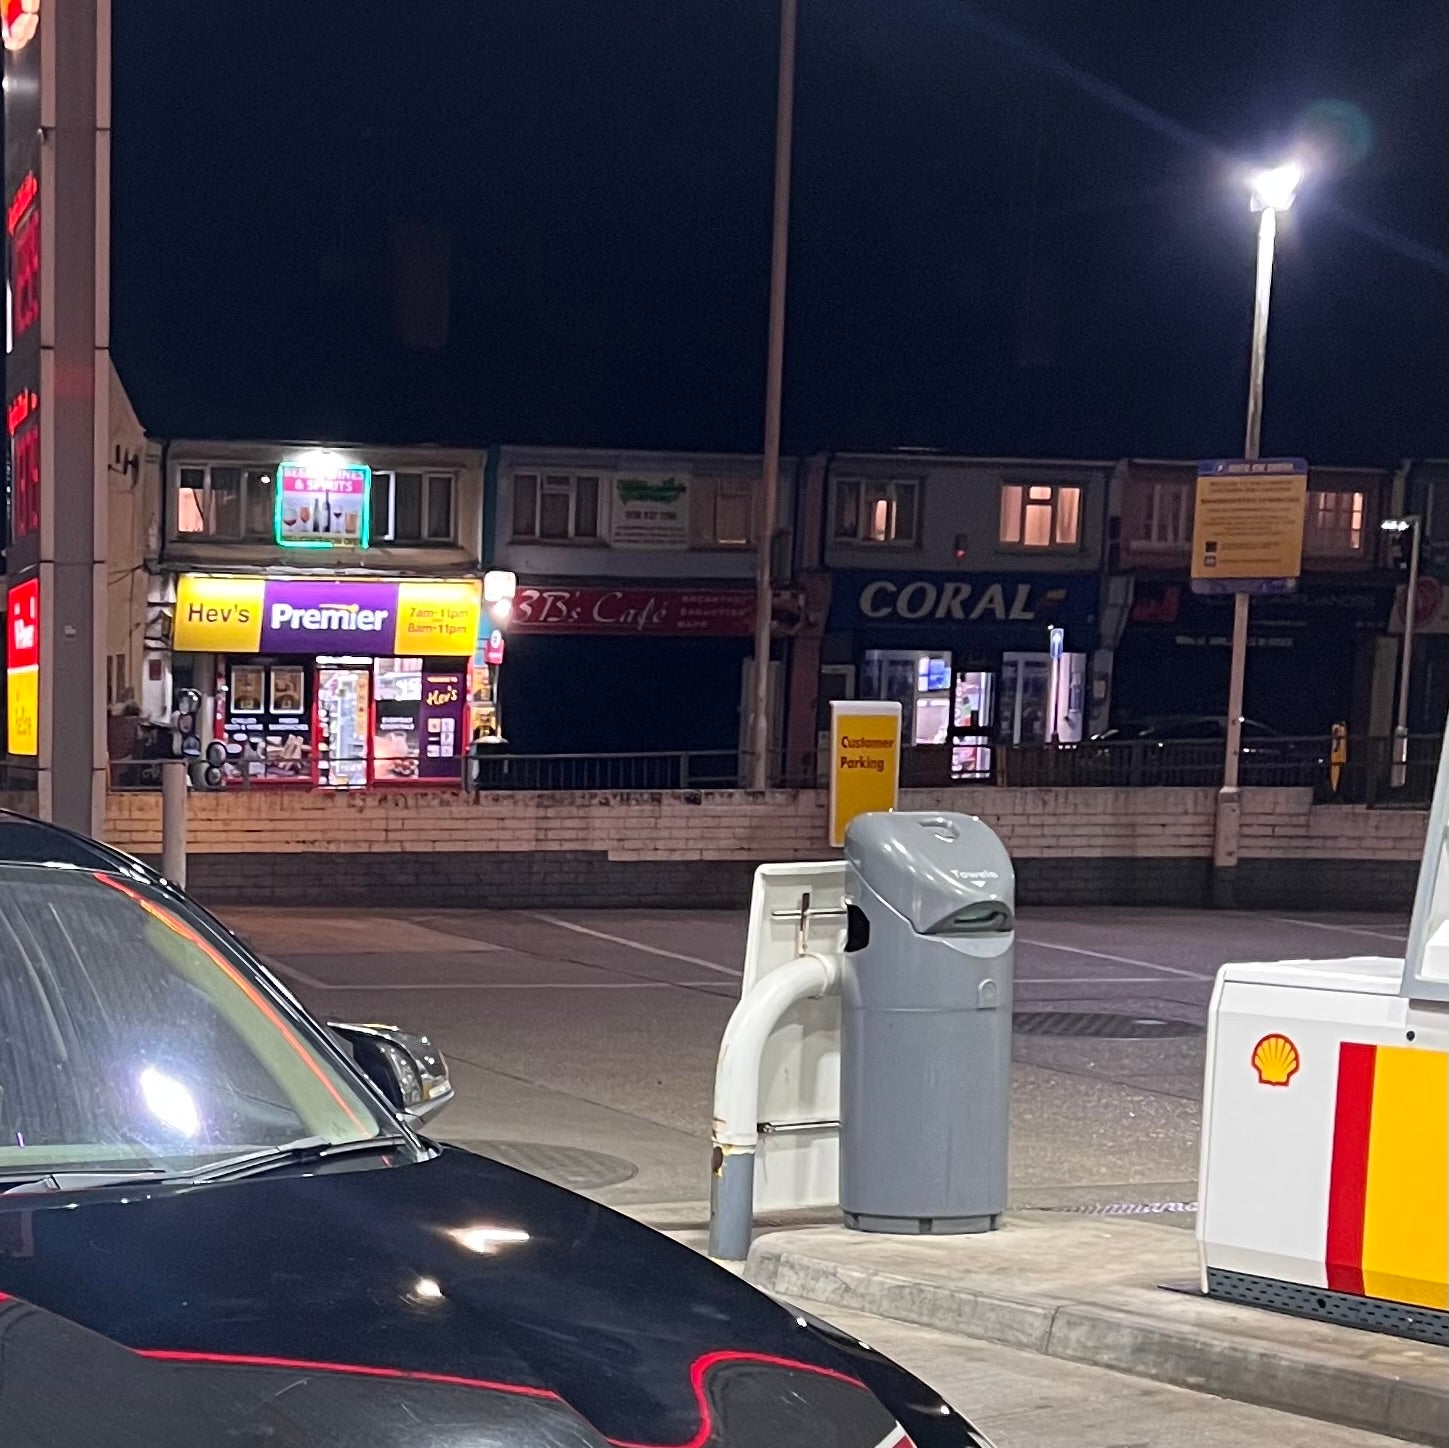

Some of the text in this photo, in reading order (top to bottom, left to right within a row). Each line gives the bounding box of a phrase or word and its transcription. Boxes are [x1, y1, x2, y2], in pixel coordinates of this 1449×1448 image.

[859, 580, 1035, 619] CORAL
[188, 603, 250, 623] Hev's
[270, 603, 389, 631] Premier
[841, 736, 895, 749] Customer
[840, 756, 885, 773] Parking
